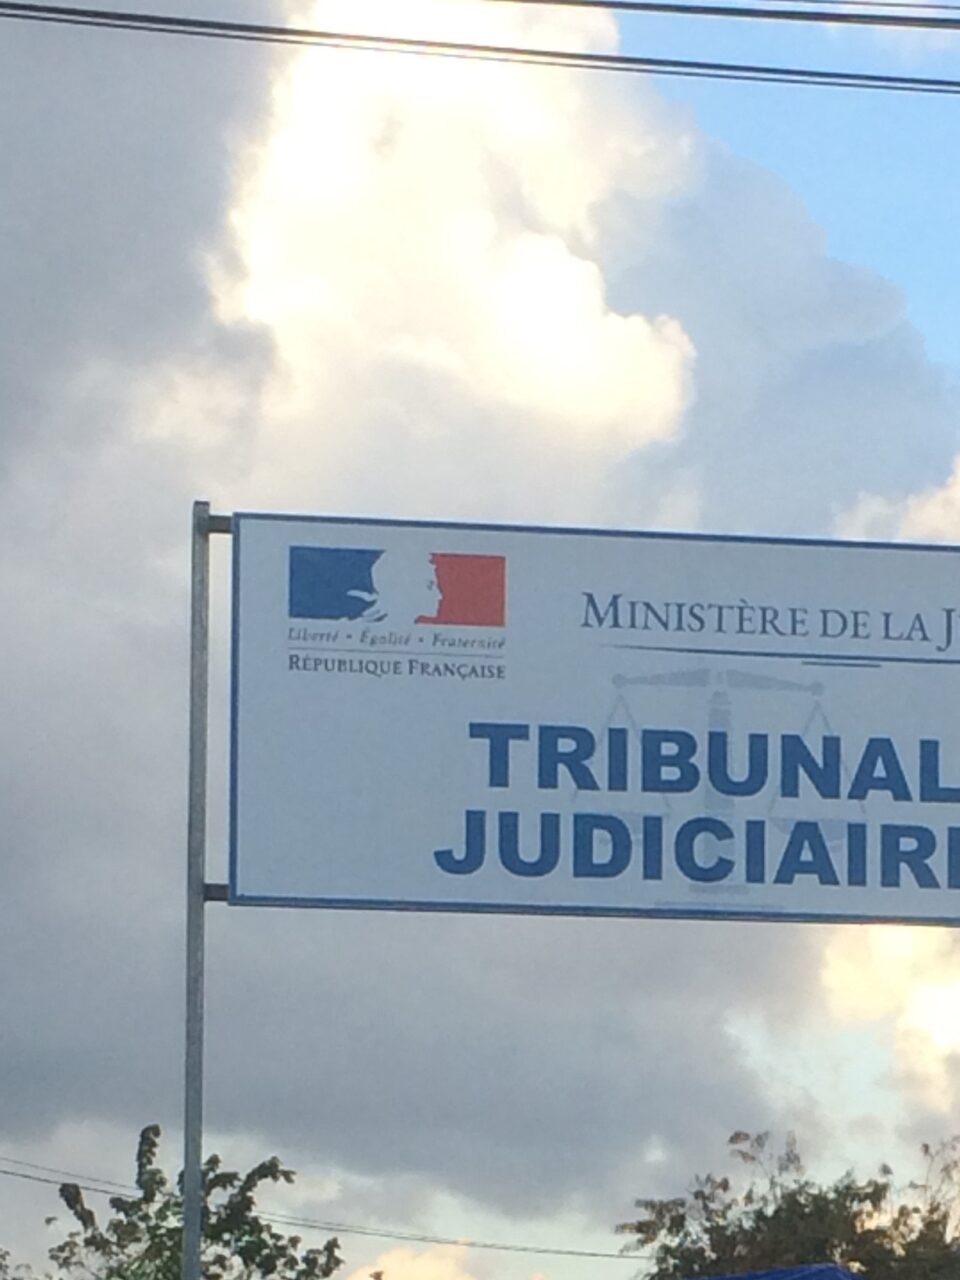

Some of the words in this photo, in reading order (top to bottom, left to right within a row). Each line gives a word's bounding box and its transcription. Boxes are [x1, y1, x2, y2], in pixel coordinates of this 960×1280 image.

[819, 608, 870, 639] DE
[882, 611, 931, 642] LA
[288, 627, 339, 643] Liberté
[359, 627, 410, 646] Égalité
[431, 632, 506, 650] Fraternité
[288, 654, 403, 677] RÉPUBLIQUE
[408, 658, 506, 680] FRANÇAISE
